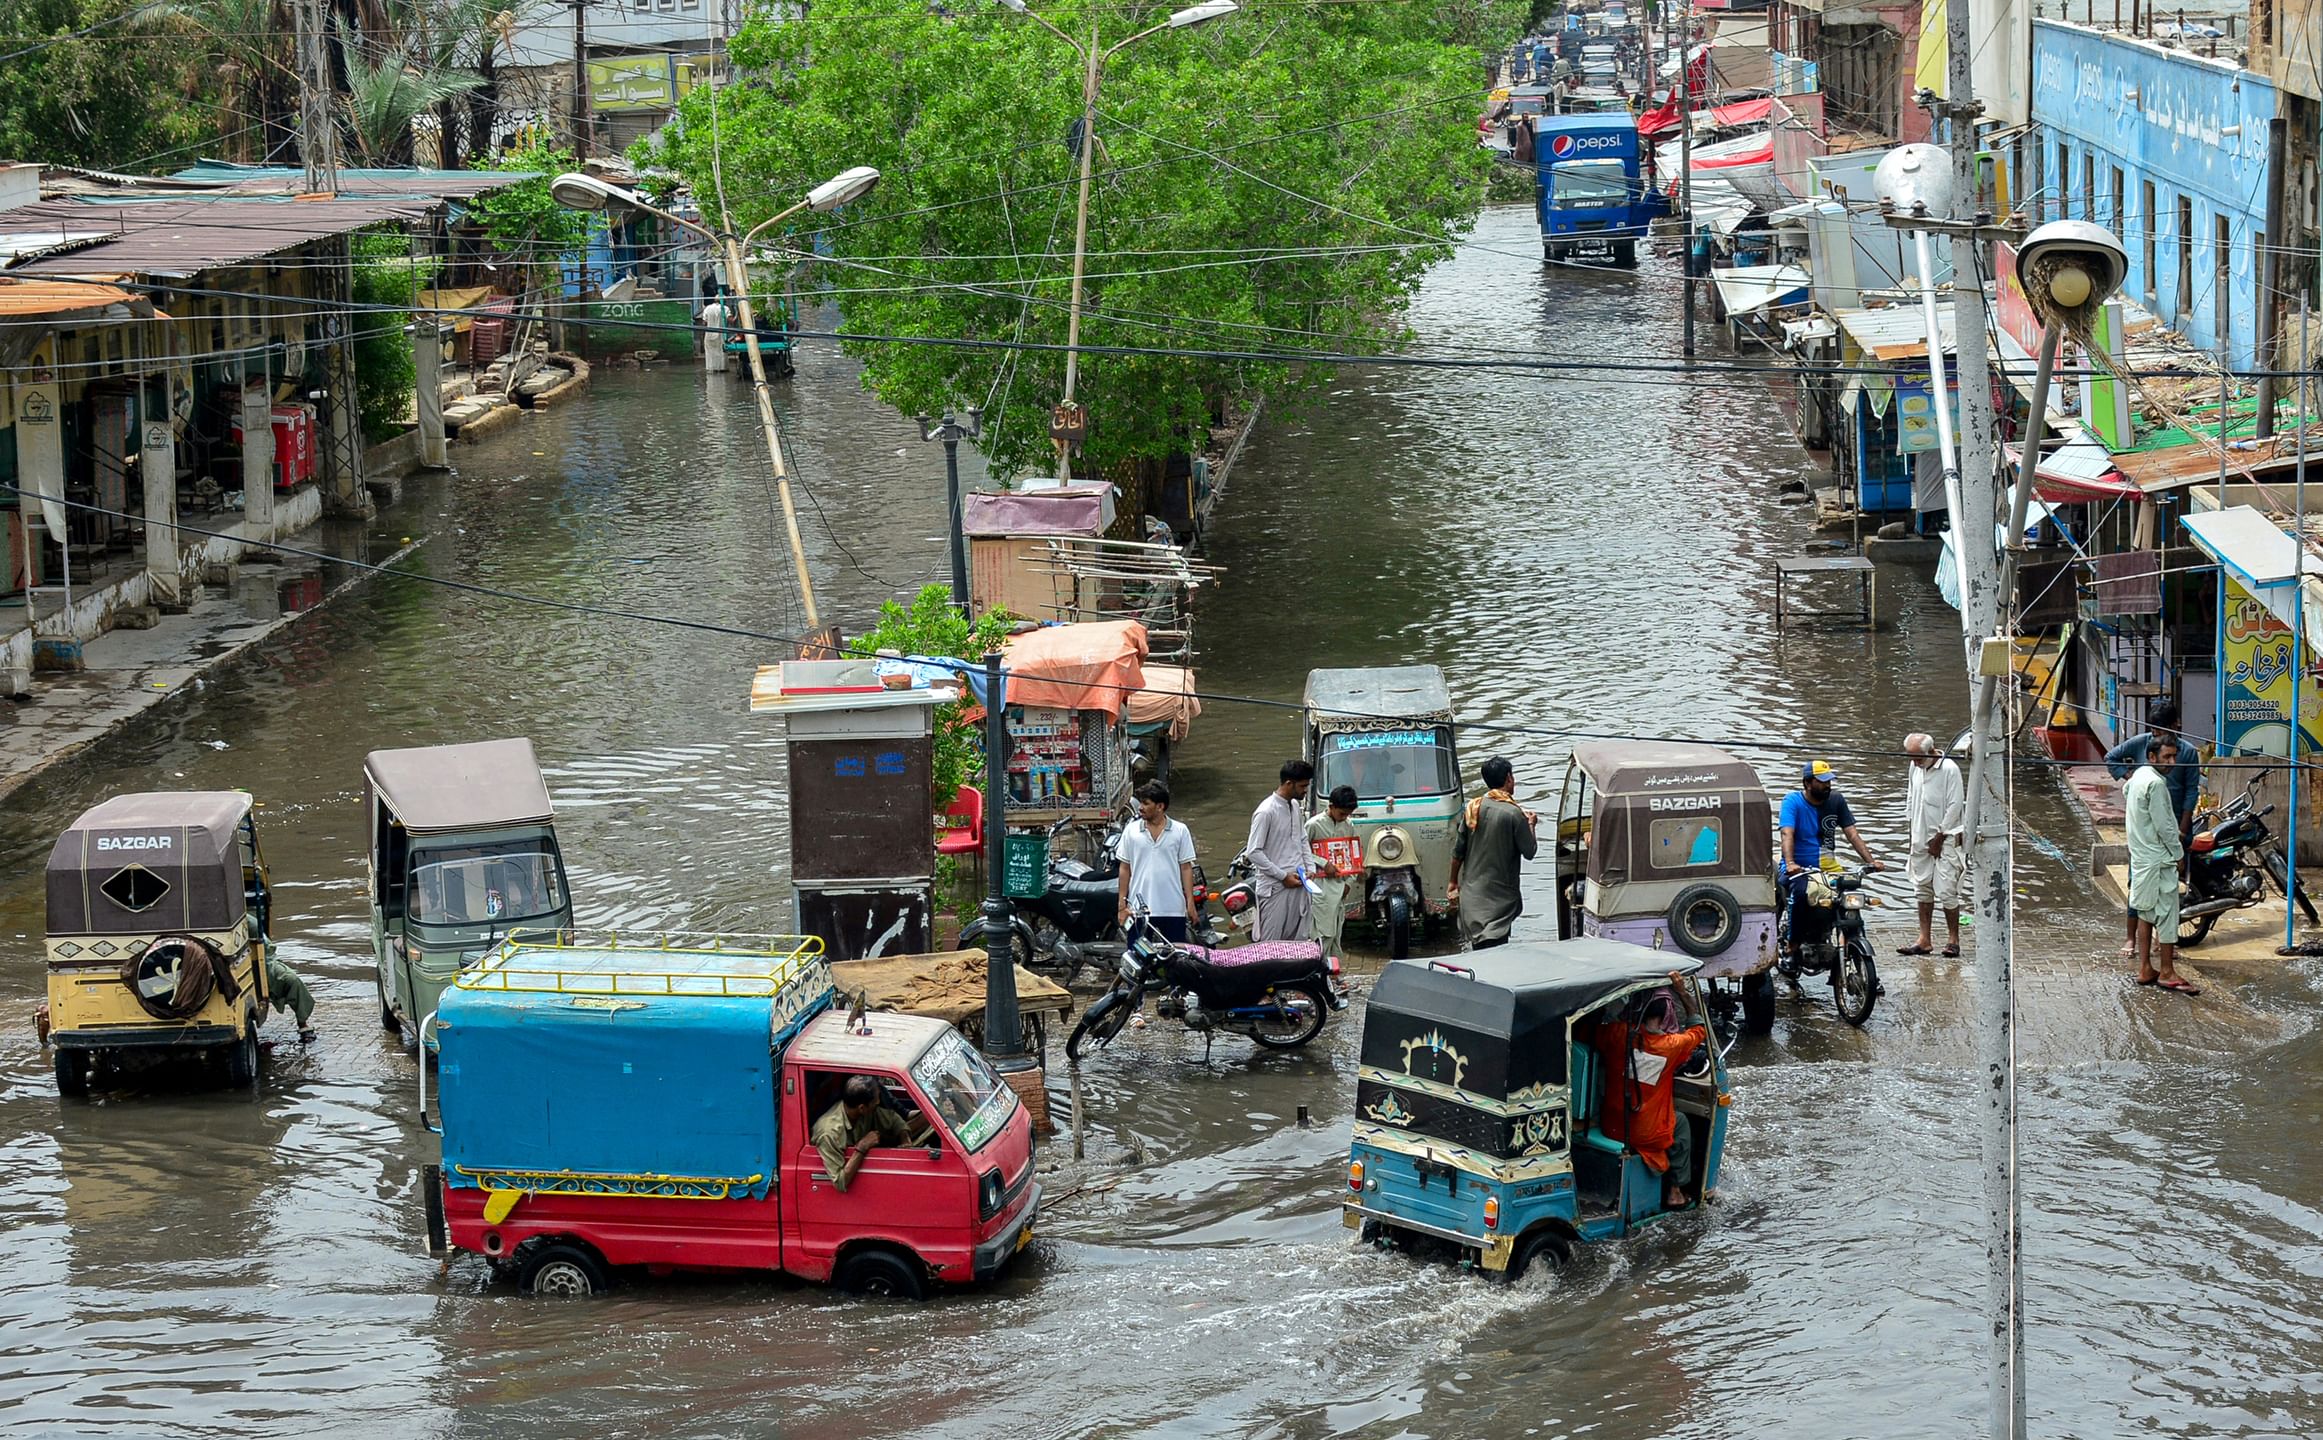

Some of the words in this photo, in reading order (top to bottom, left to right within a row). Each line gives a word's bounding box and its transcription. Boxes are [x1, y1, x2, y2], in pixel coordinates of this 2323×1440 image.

[594, 83, 665, 104] سوات
[2244, 113, 2270, 170] pep
[2228, 700, 2280, 710] 0303-9054520
[1649, 795, 1722, 812] SAZGAR
[97, 836, 172, 850] SAZGAR
